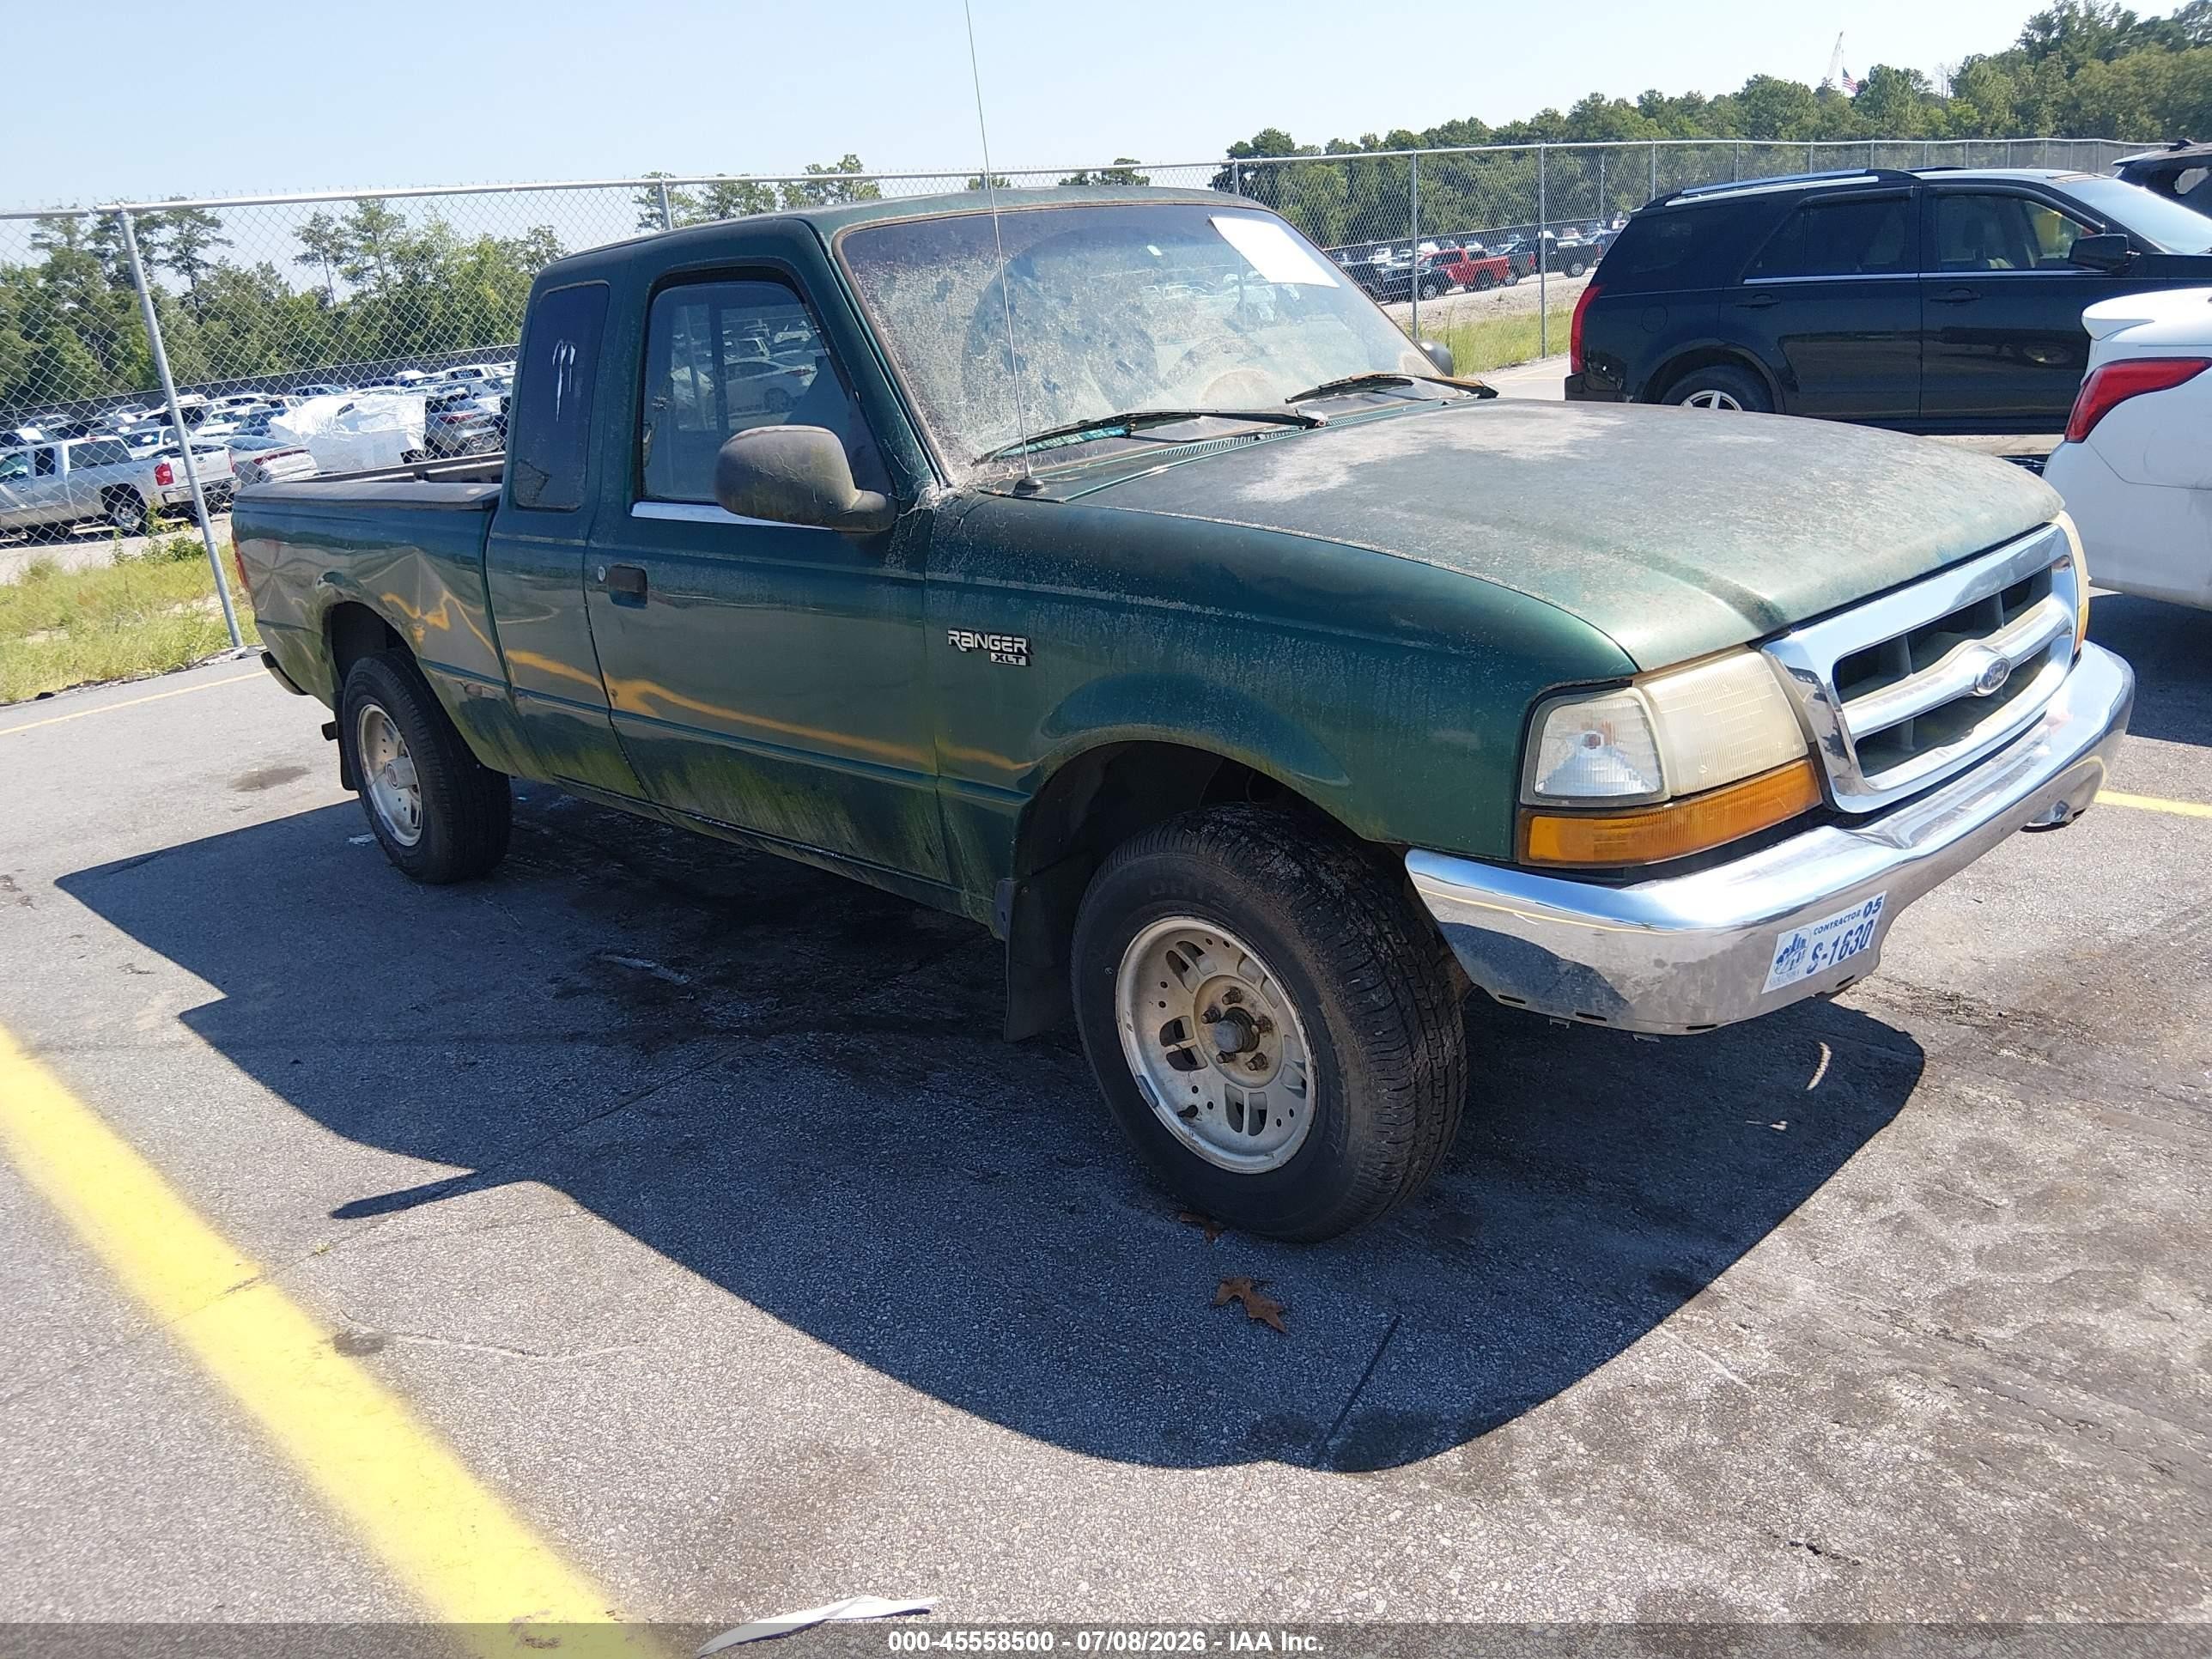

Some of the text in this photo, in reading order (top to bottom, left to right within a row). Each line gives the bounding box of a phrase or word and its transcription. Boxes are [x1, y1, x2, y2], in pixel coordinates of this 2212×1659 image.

[994, 653, 1023, 664] XLT
[1813, 896, 1883, 935] CONTRACTOR 05
[1806, 919, 1875, 975] S-1630
